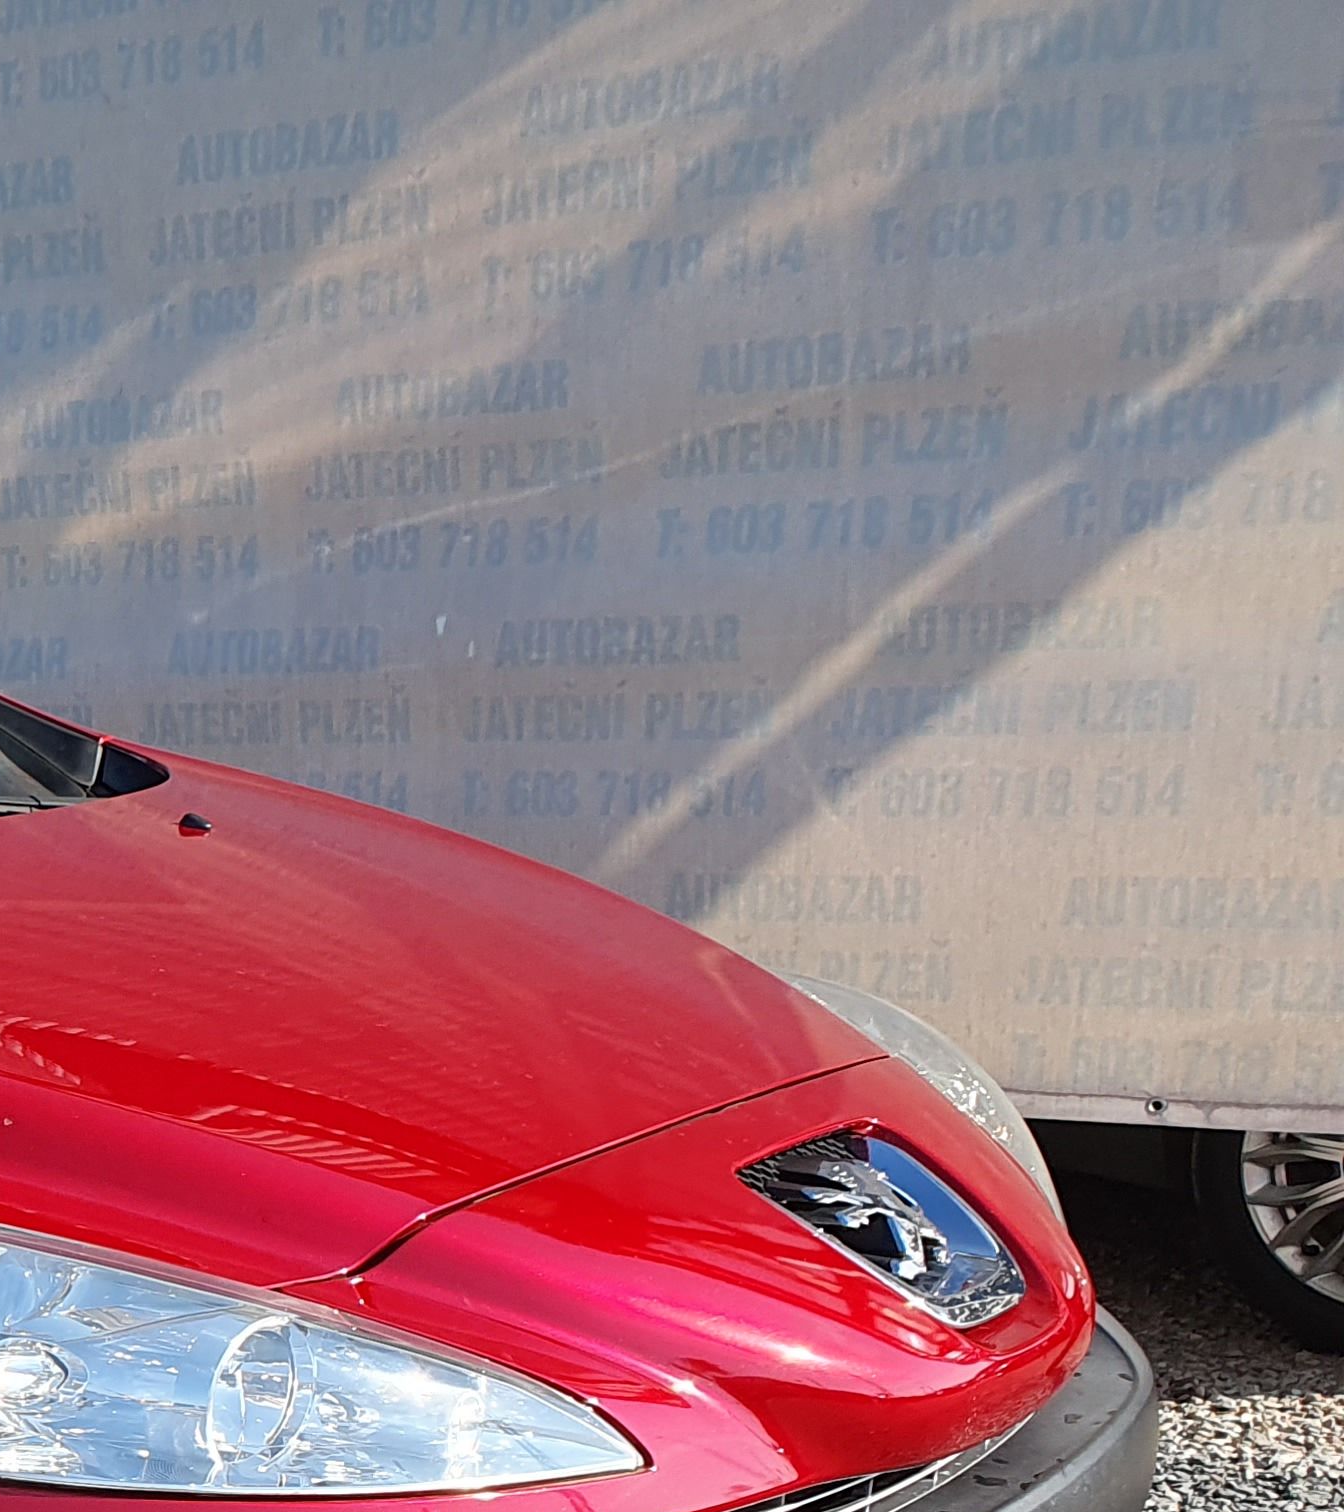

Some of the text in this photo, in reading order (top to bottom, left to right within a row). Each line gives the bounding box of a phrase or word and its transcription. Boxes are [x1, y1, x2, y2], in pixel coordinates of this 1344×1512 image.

[2, 212, 107, 284] PLZEŇ
[40, 304, 105, 352] 514
[696, 322, 973, 396] AUTOBAZAR
[335, 357, 570, 428] AUTOBAZAR
[305, 420, 604, 501] JATEČNÍ PLZEŇ
[658, 385, 1010, 480] JATEČNÍ PLZEŇ
[308, 515, 601, 576] T: 603 718 514
[655, 487, 1002, 561] T: 603 718 514
[494, 613, 742, 669] AUTOBAZAR
[461, 675, 776, 744] JATEČNÍ PLZEŇ
[463, 768, 767, 819] T: 603 718 514
